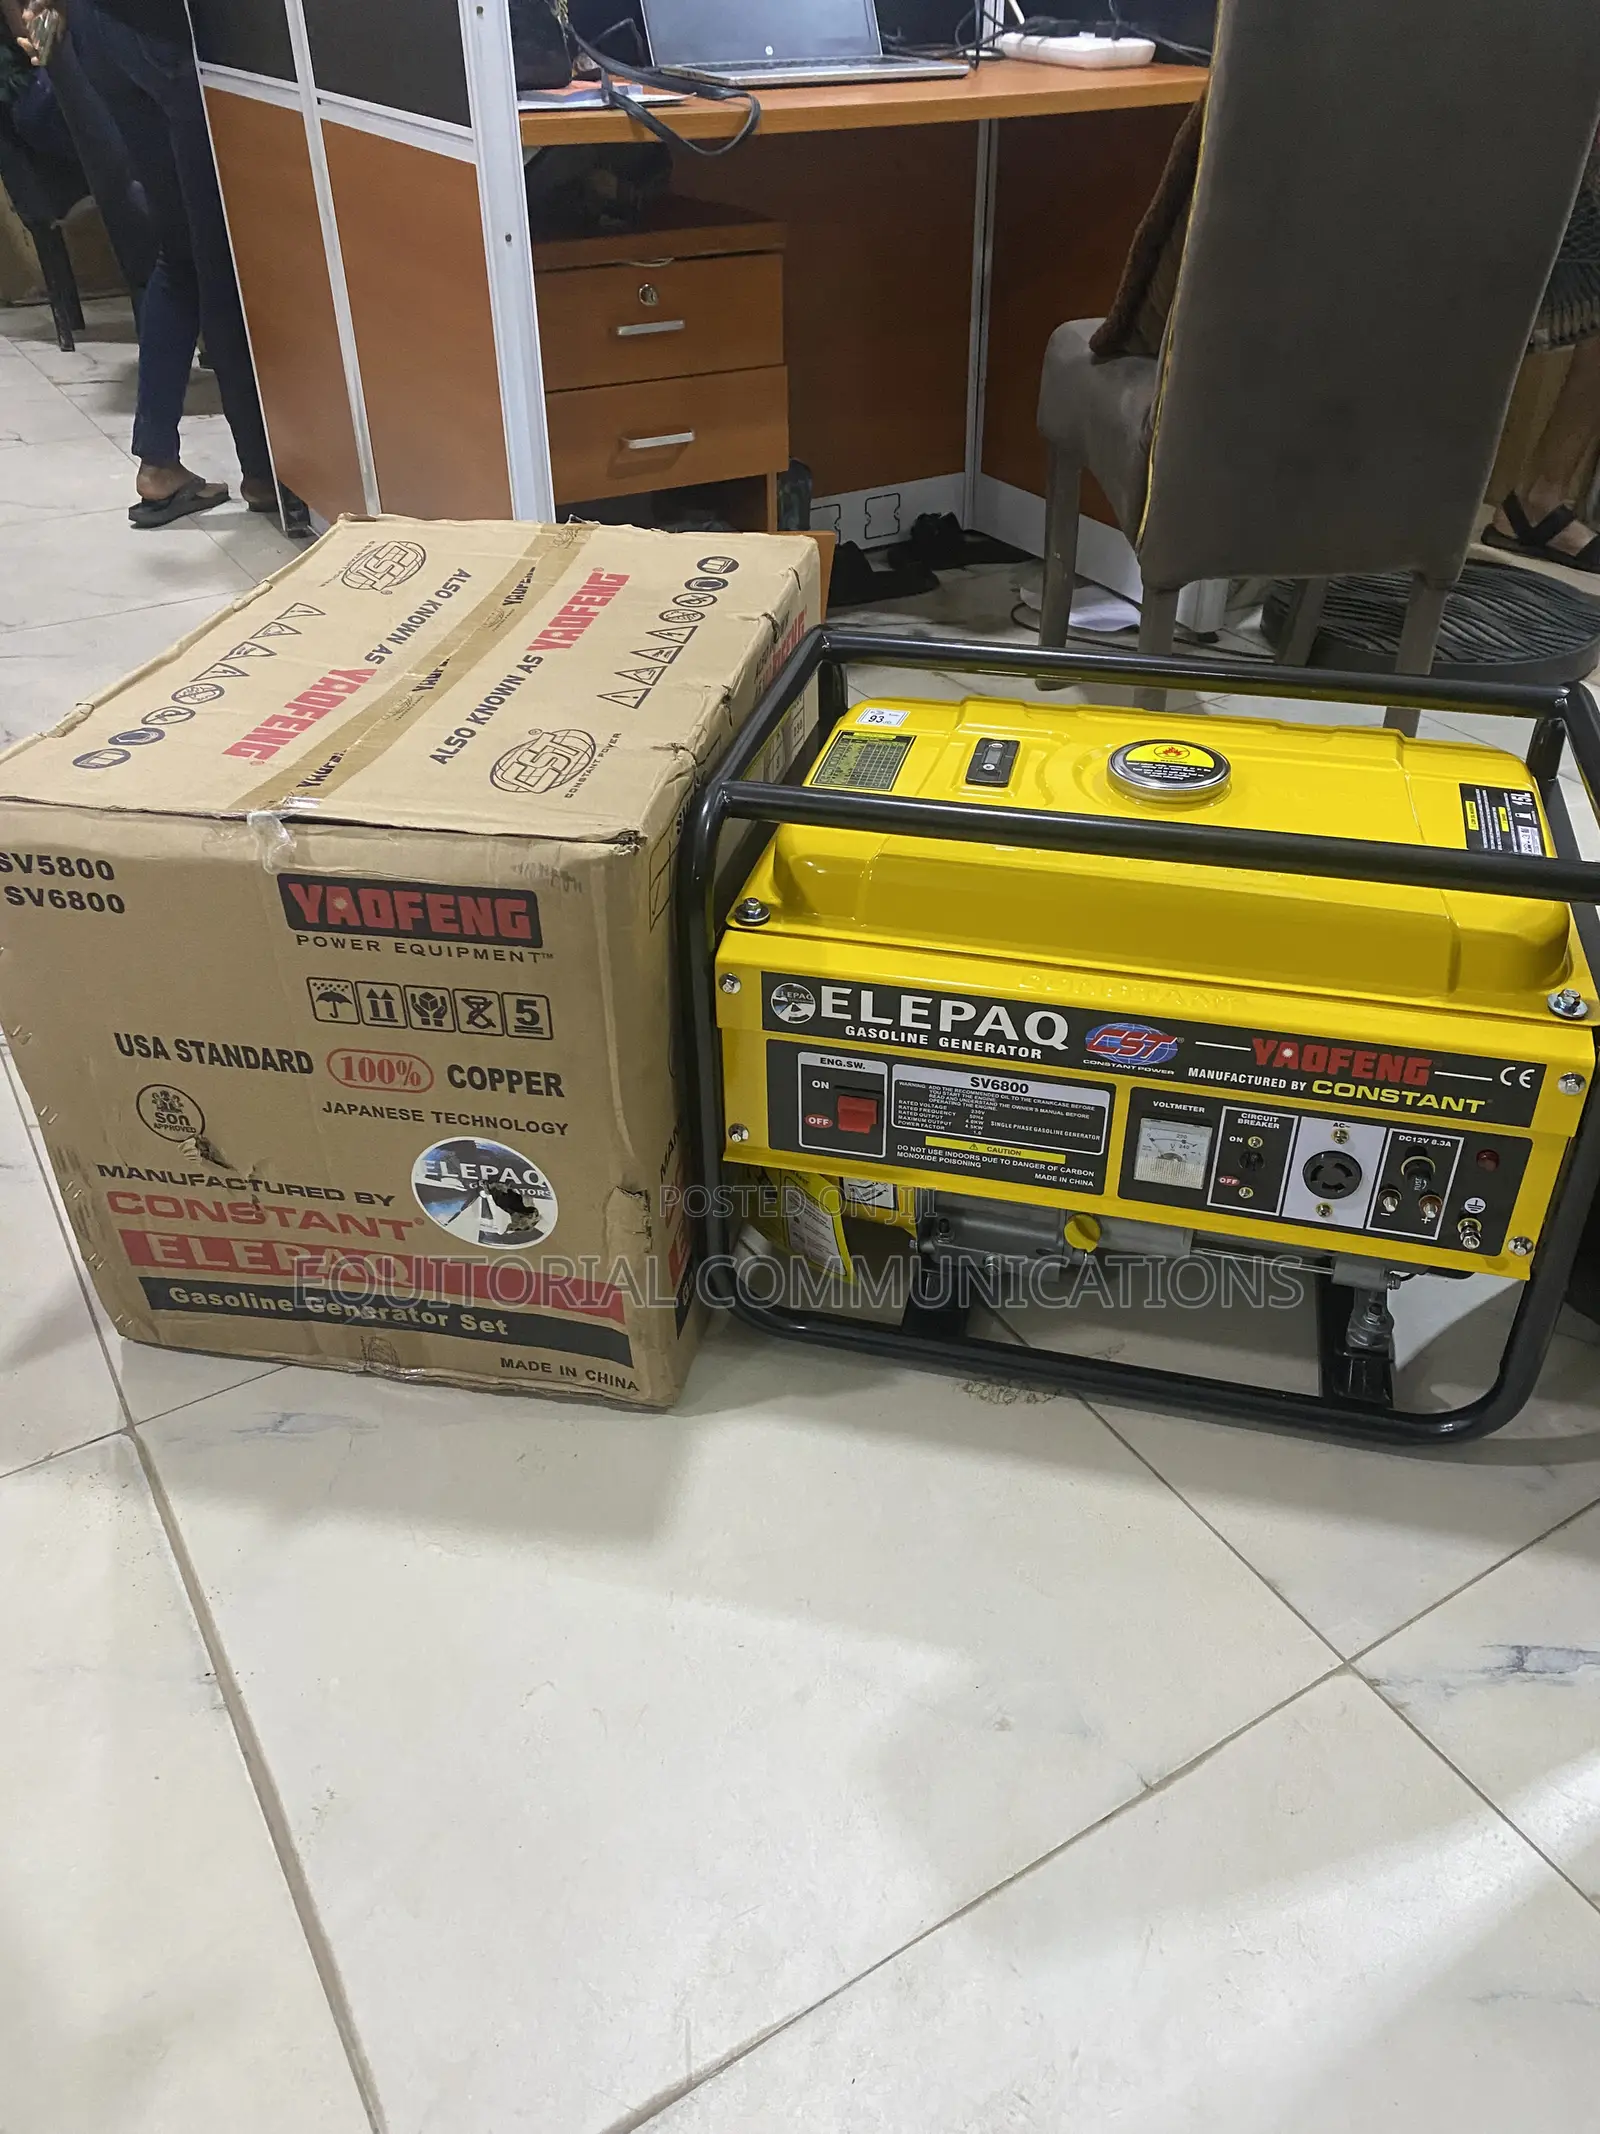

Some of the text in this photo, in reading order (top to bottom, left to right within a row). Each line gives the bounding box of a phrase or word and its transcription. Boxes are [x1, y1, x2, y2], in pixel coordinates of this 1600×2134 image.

[434, 568, 472, 599] ALSO
[386, 599, 443, 645] KNOWN
[525, 572, 631, 651] YAOFENG
[364, 643, 393, 664] AS
[516, 654, 544, 674] AS
[465, 674, 526, 725] KNOWN
[222, 668, 378, 761] YAOFENG
[869, 714, 885, 724] 93
[429, 727, 476, 764] ALSO
[564, 758, 600, 799] CONSTANT
[0, 853, 114, 881] SV5800
[4, 886, 125, 914] SV6800
[287, 883, 533, 939] YAOFENG
[296, 934, 381, 953] POWER
[821, 985, 1069, 1051] ELEPAQ
[114, 1033, 314, 1075] USA STANDARD
[845, 1025, 1042, 1059] GASOLINE GENERATOR
[1086, 1028, 1178, 1059] CST
[340, 1055, 421, 1088] 100%
[820, 1056, 866, 1070] ENG.SW.
[1083, 1059, 1175, 1076] CONSTANT POWER
[1252, 1038, 1433, 1086] YAOFENG
[447, 1064, 565, 1098] COPPER
[811, 1079, 830, 1090] ON
[970, 1077, 1030, 1095] SV6800
[1188, 1066, 1486, 1114] MANUFACTURED BY CONSTANT
[1500, 1066, 1536, 1089] CE
[919, 1102, 947, 1110] VOLTAGE
[919, 1107, 957, 1116] FREQUENCY
[954, 1088, 1000, 1099] RECOMMENDED
[1033, 1099, 1070, 1108] CRANKCASE
[1071, 1103, 1095, 1111] BEFORE
[959, 1097, 998, 1107] UNDERSTAND
[1040, 1108, 1065, 1116] MANUAL
[1065, 1111, 1090, 1119] BEFORE
[1153, 1100, 1205, 1113] VOLTMETER
[153, 1122, 197, 1133] APPROVED
[322, 1101, 568, 1136] JAPANESE TECHNOLOGY
[809, 1116, 830, 1127] OFF
[898, 1115, 926, 1123] MAXIMUM
[928, 1118, 952, 1126] OUTPUT
[1237, 1118, 1280, 1130] BREAKER
[1241, 1112, 1280, 1123] CIRCUIT
[990, 1120, 1101, 1141] SINGLE PHASE GASOLINE GENERATOR
[1229, 1135, 1244, 1143] ON
[1398, 1134, 1430, 1145] DC12V
[897, 1151, 982, 1168] MONOXIDE POISONING
[945, 1150, 981, 1161] INDOORS
[1012, 1160, 1046, 1170] DANGER
[1060, 1166, 1095, 1177] CARBON
[986, 1146, 1022, 1156] CAUTION
[96, 1164, 395, 1207] MANUFACTURED BY
[424, 1160, 546, 1188] ELEPAQ
[1034, 1173, 1058, 1182] MADE
[1069, 1178, 1094, 1187] CHINA
[1219, 1177, 1238, 1185] OFF
[106, 1191, 413, 1241] CONSTANT
[144, 1234, 412, 1287] ELEPAQ
[168, 1286, 509, 1337] Gasoline Generator Set
[500, 1356, 640, 1392] MADE IN CHINA
